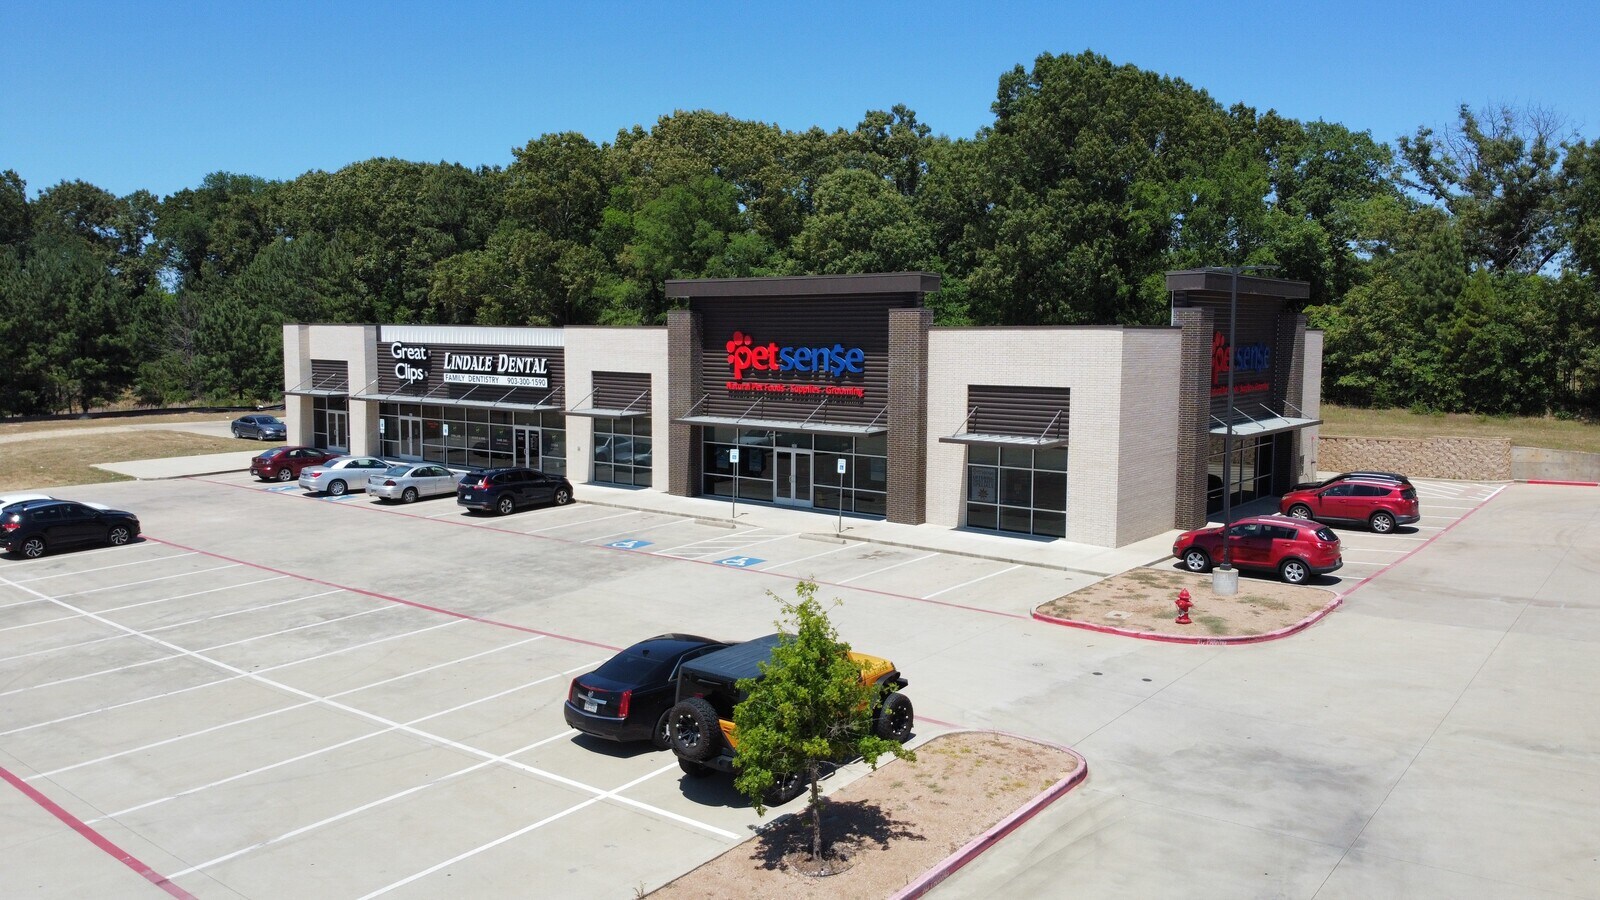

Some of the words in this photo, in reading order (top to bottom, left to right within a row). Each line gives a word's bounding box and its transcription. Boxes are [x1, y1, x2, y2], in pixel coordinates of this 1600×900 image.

[391, 341, 427, 360] Great
[443, 352, 493, 372] LINDALE
[497, 354, 548, 374] DENTAL
[395, 363, 424, 384] Clips
[445, 374, 465, 382] FAMILY
[468, 375, 499, 383] DENTISTRY
[507, 377, 546, 387] 903-300-1590
[726, 381, 750, 391] Natural
[751, 383, 763, 392] Pet
[764, 383, 785, 393] Foods
[790, 384, 820, 394] Supplies
[826, 386, 864, 397] Grooming
